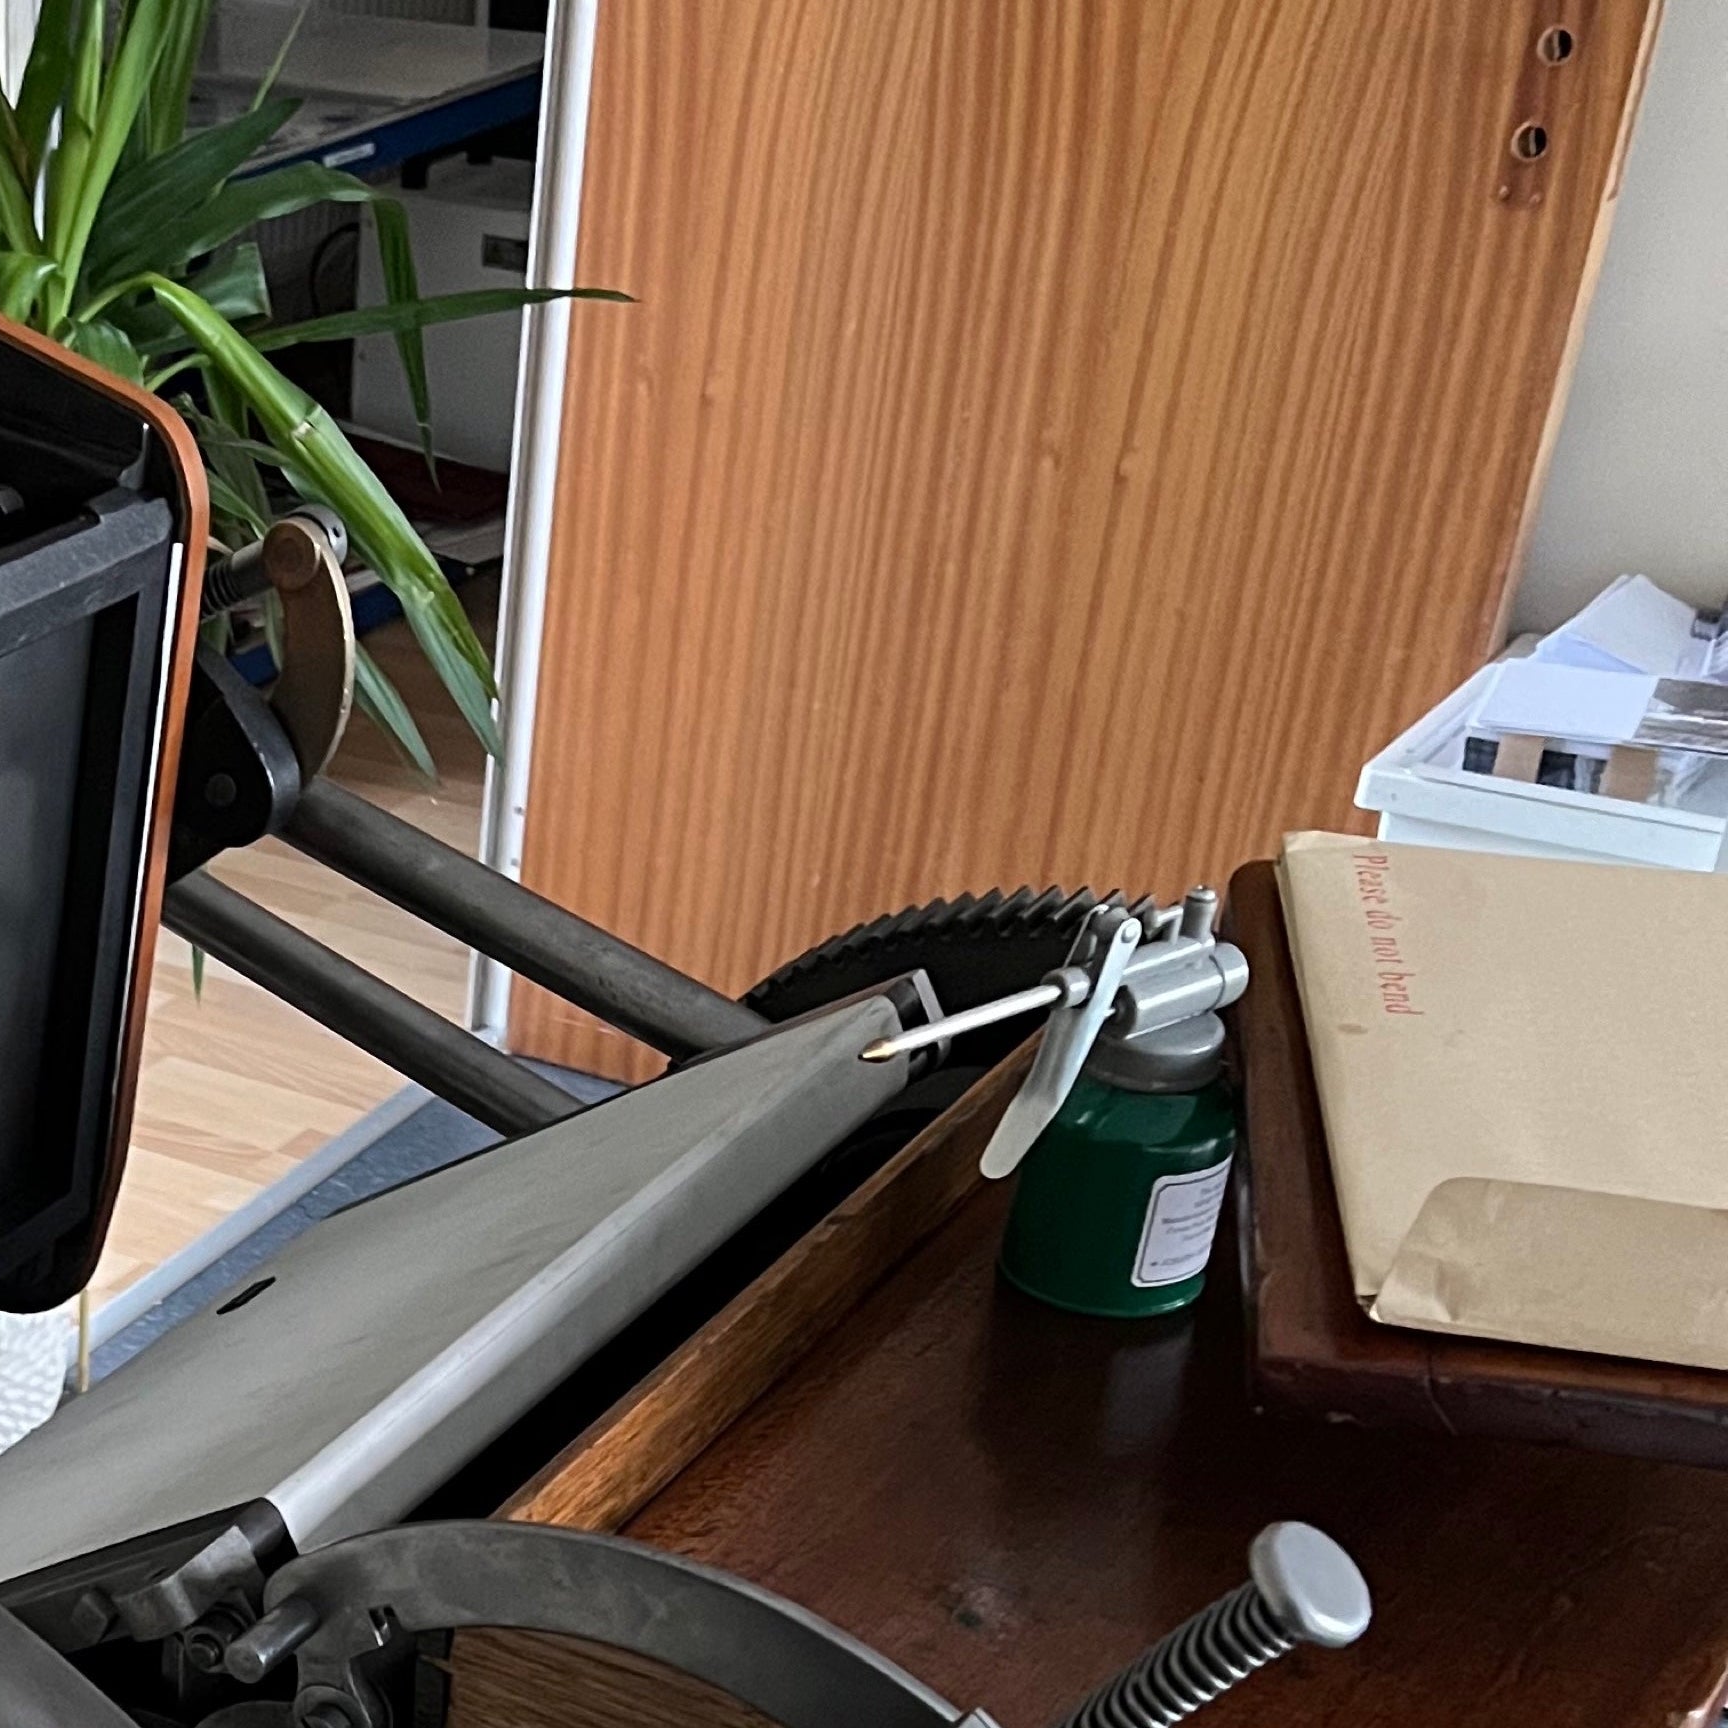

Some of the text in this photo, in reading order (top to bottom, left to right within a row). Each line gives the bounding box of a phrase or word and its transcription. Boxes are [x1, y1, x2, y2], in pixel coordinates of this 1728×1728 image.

[1353, 855, 1424, 1015] Please do not bend
